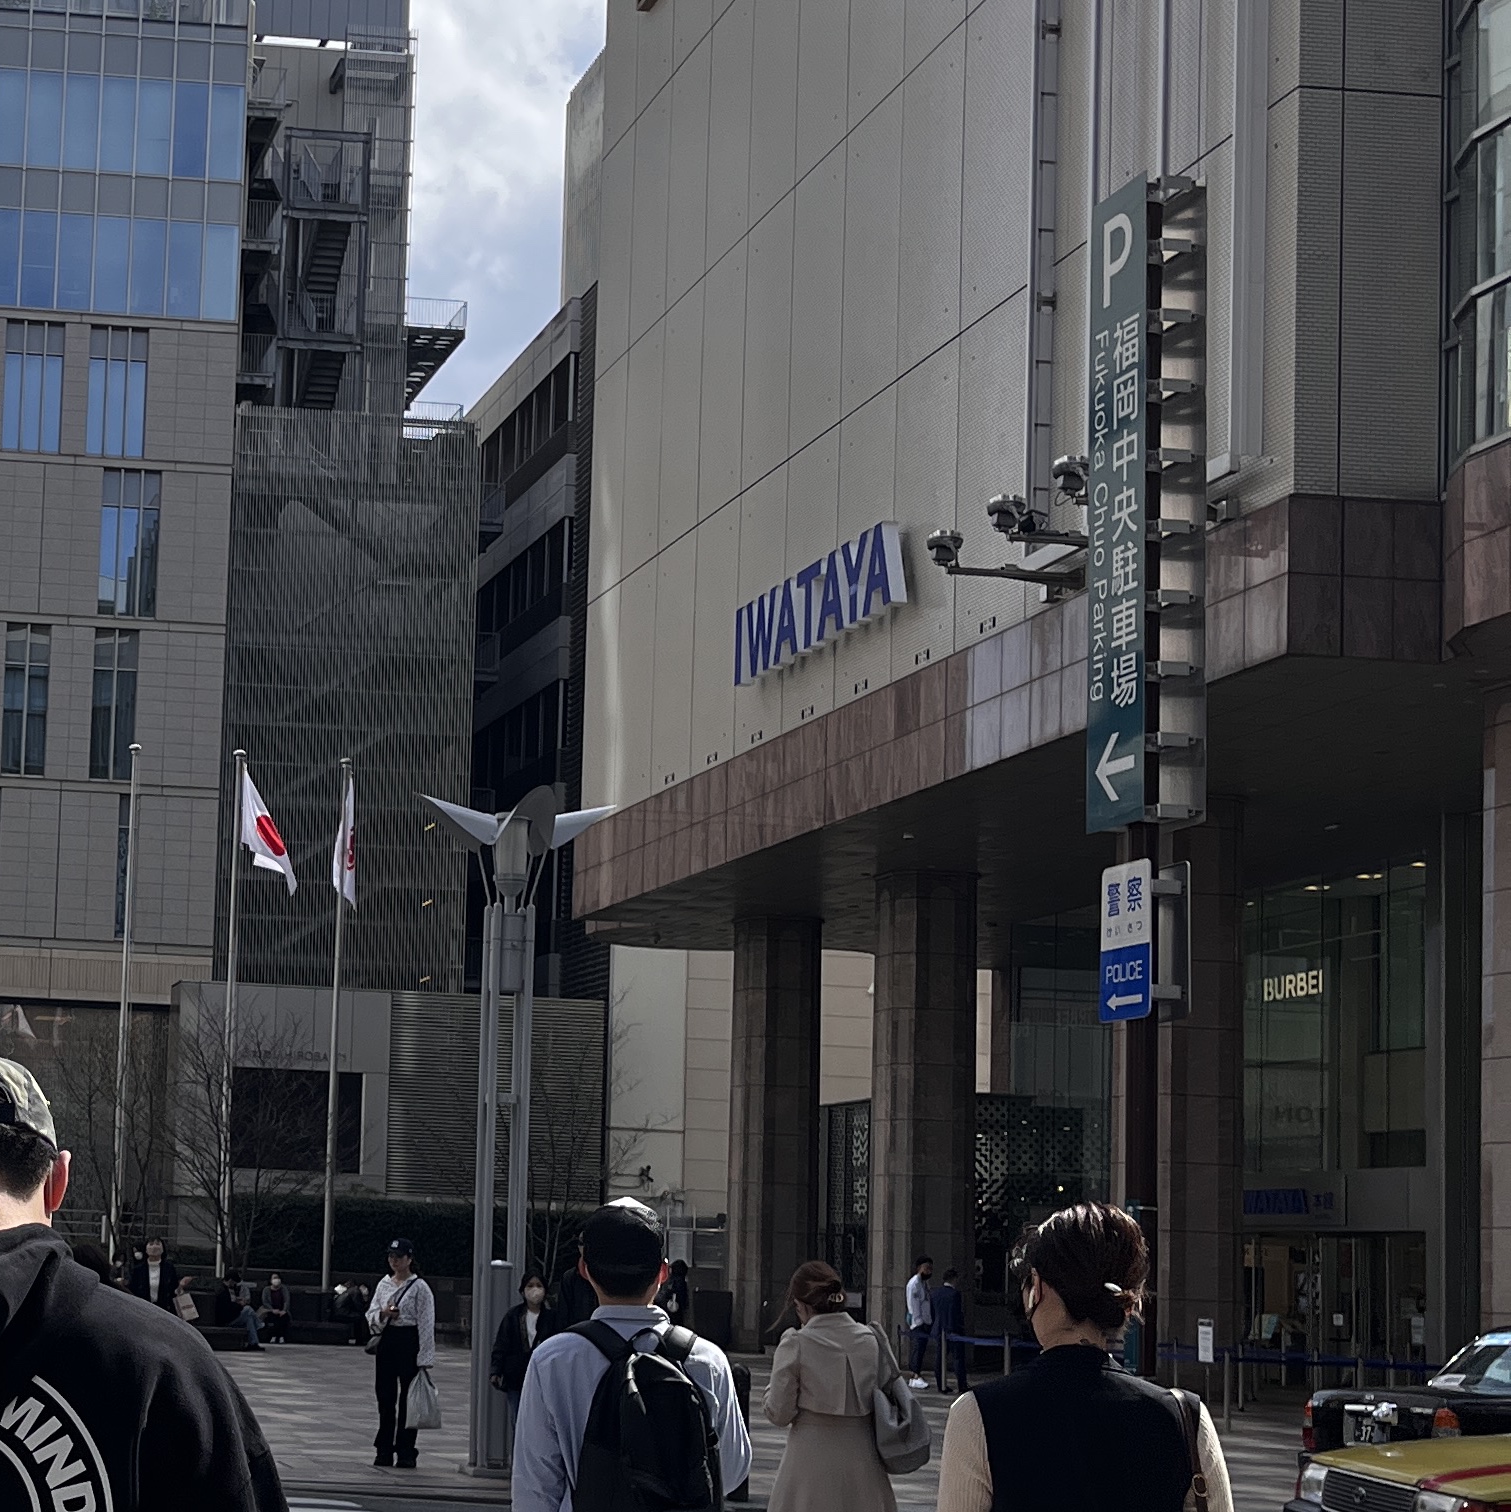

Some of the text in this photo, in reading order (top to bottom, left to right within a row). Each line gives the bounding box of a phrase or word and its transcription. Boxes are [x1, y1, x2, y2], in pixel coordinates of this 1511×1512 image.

[1102, 212, 1133, 309] P
[1089, 330, 1109, 702] Fukuoka Chuo Parking
[1109, 311, 1139, 708] 福岡中央駐車場
[734, 521, 896, 687] IWATAYA
[1105, 876, 1142, 918] 警察
[1104, 959, 1143, 985] POLICE
